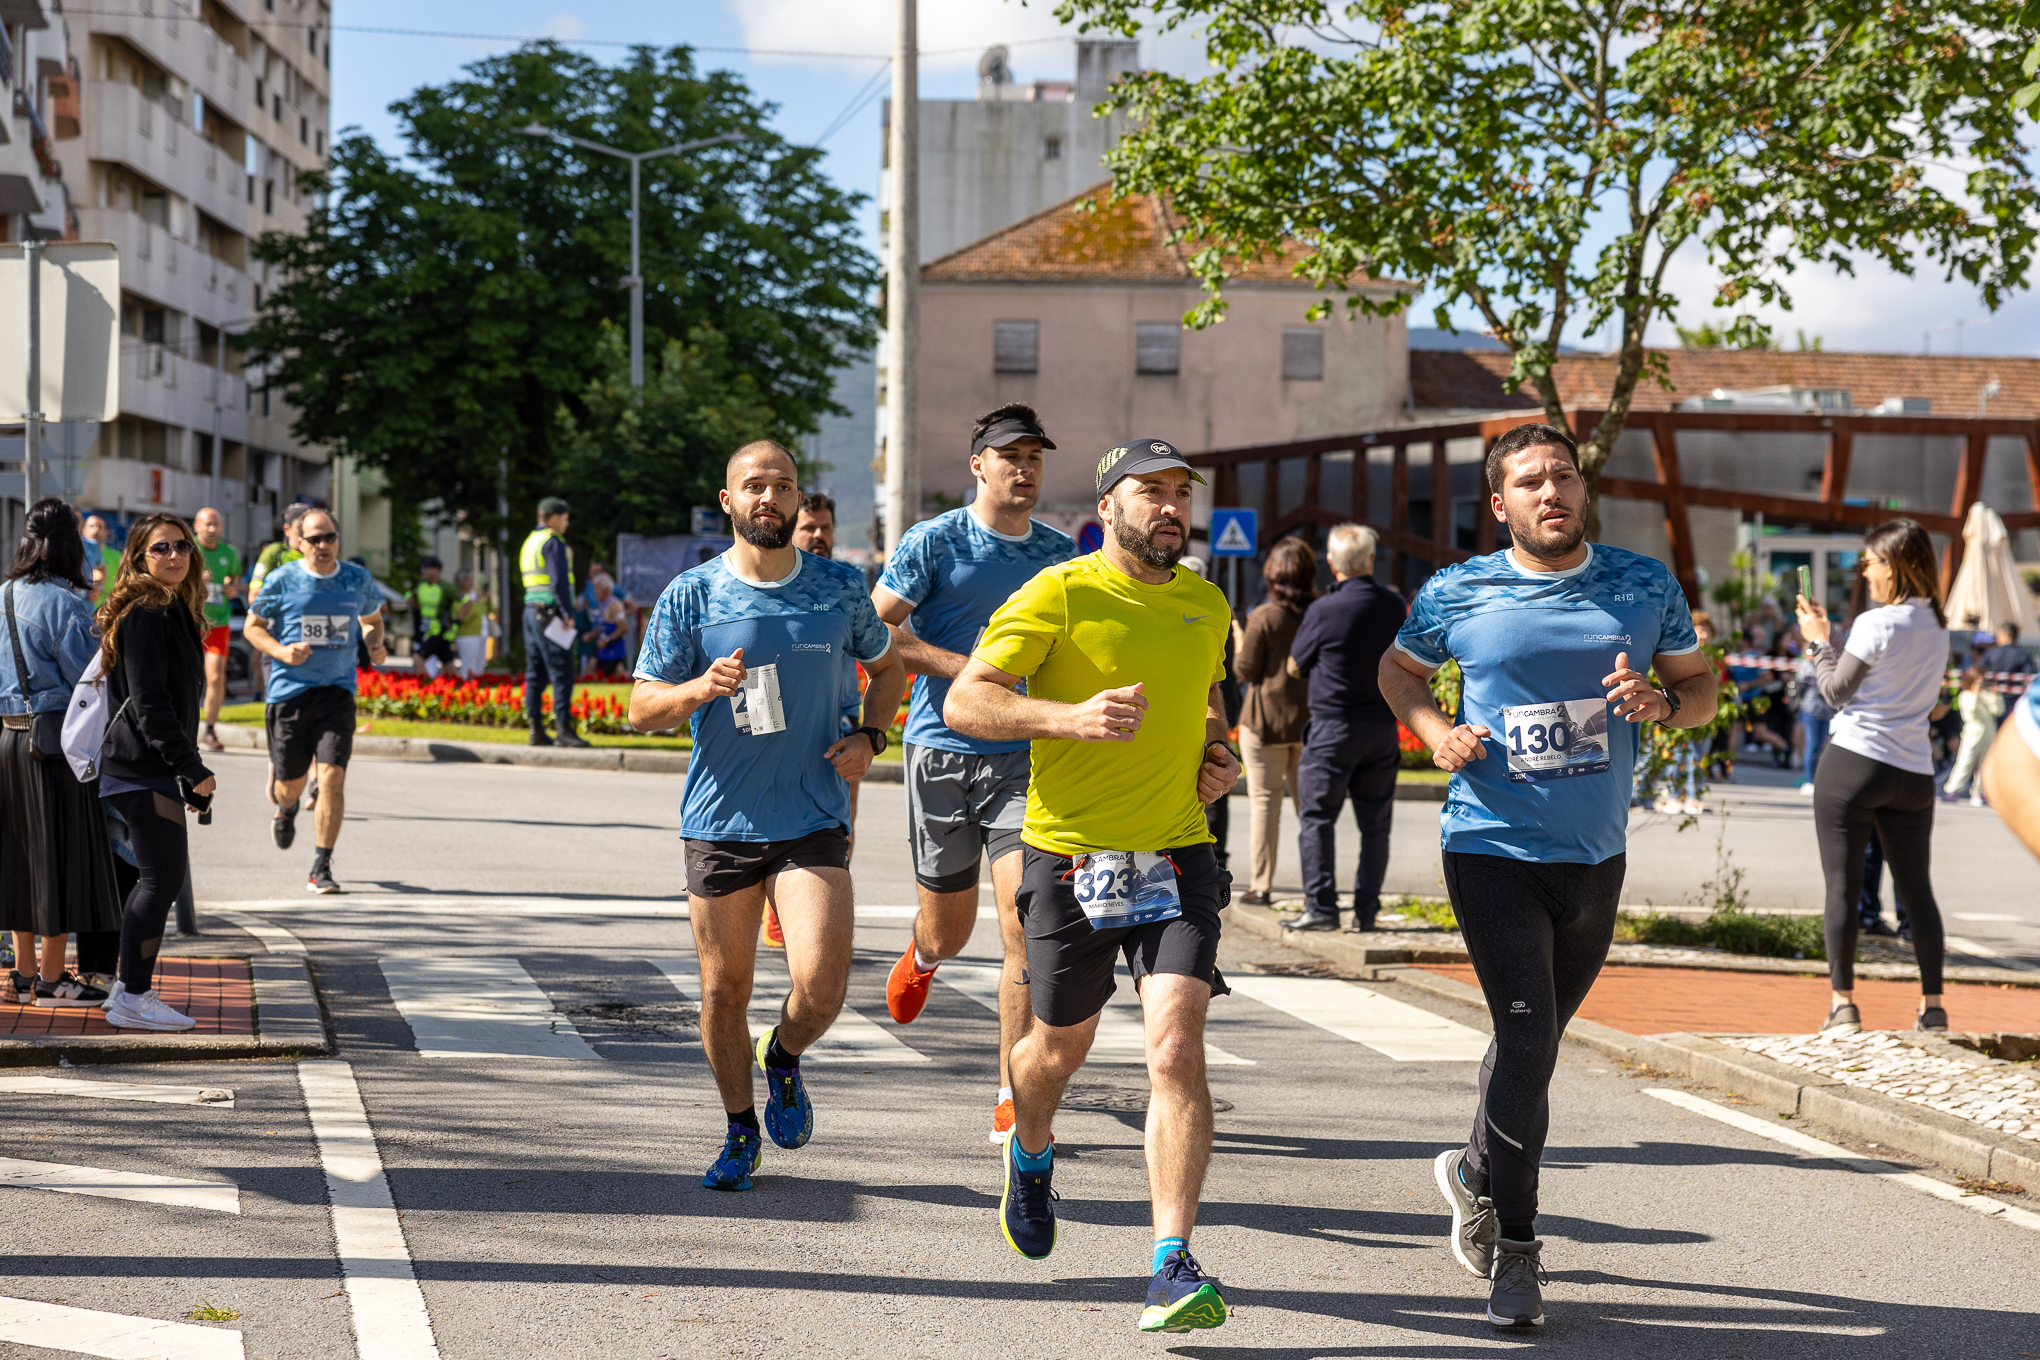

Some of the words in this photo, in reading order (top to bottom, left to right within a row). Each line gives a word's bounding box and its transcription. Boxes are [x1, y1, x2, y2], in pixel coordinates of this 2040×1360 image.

[303, 624, 330, 638] 381
[1508, 721, 1571, 757] 130
[1540, 754, 1562, 762] REBELO
[1514, 772, 1527, 780] 10K
[1093, 854, 1126, 864] CAMBRA
[1076, 868, 1135, 903] 323
